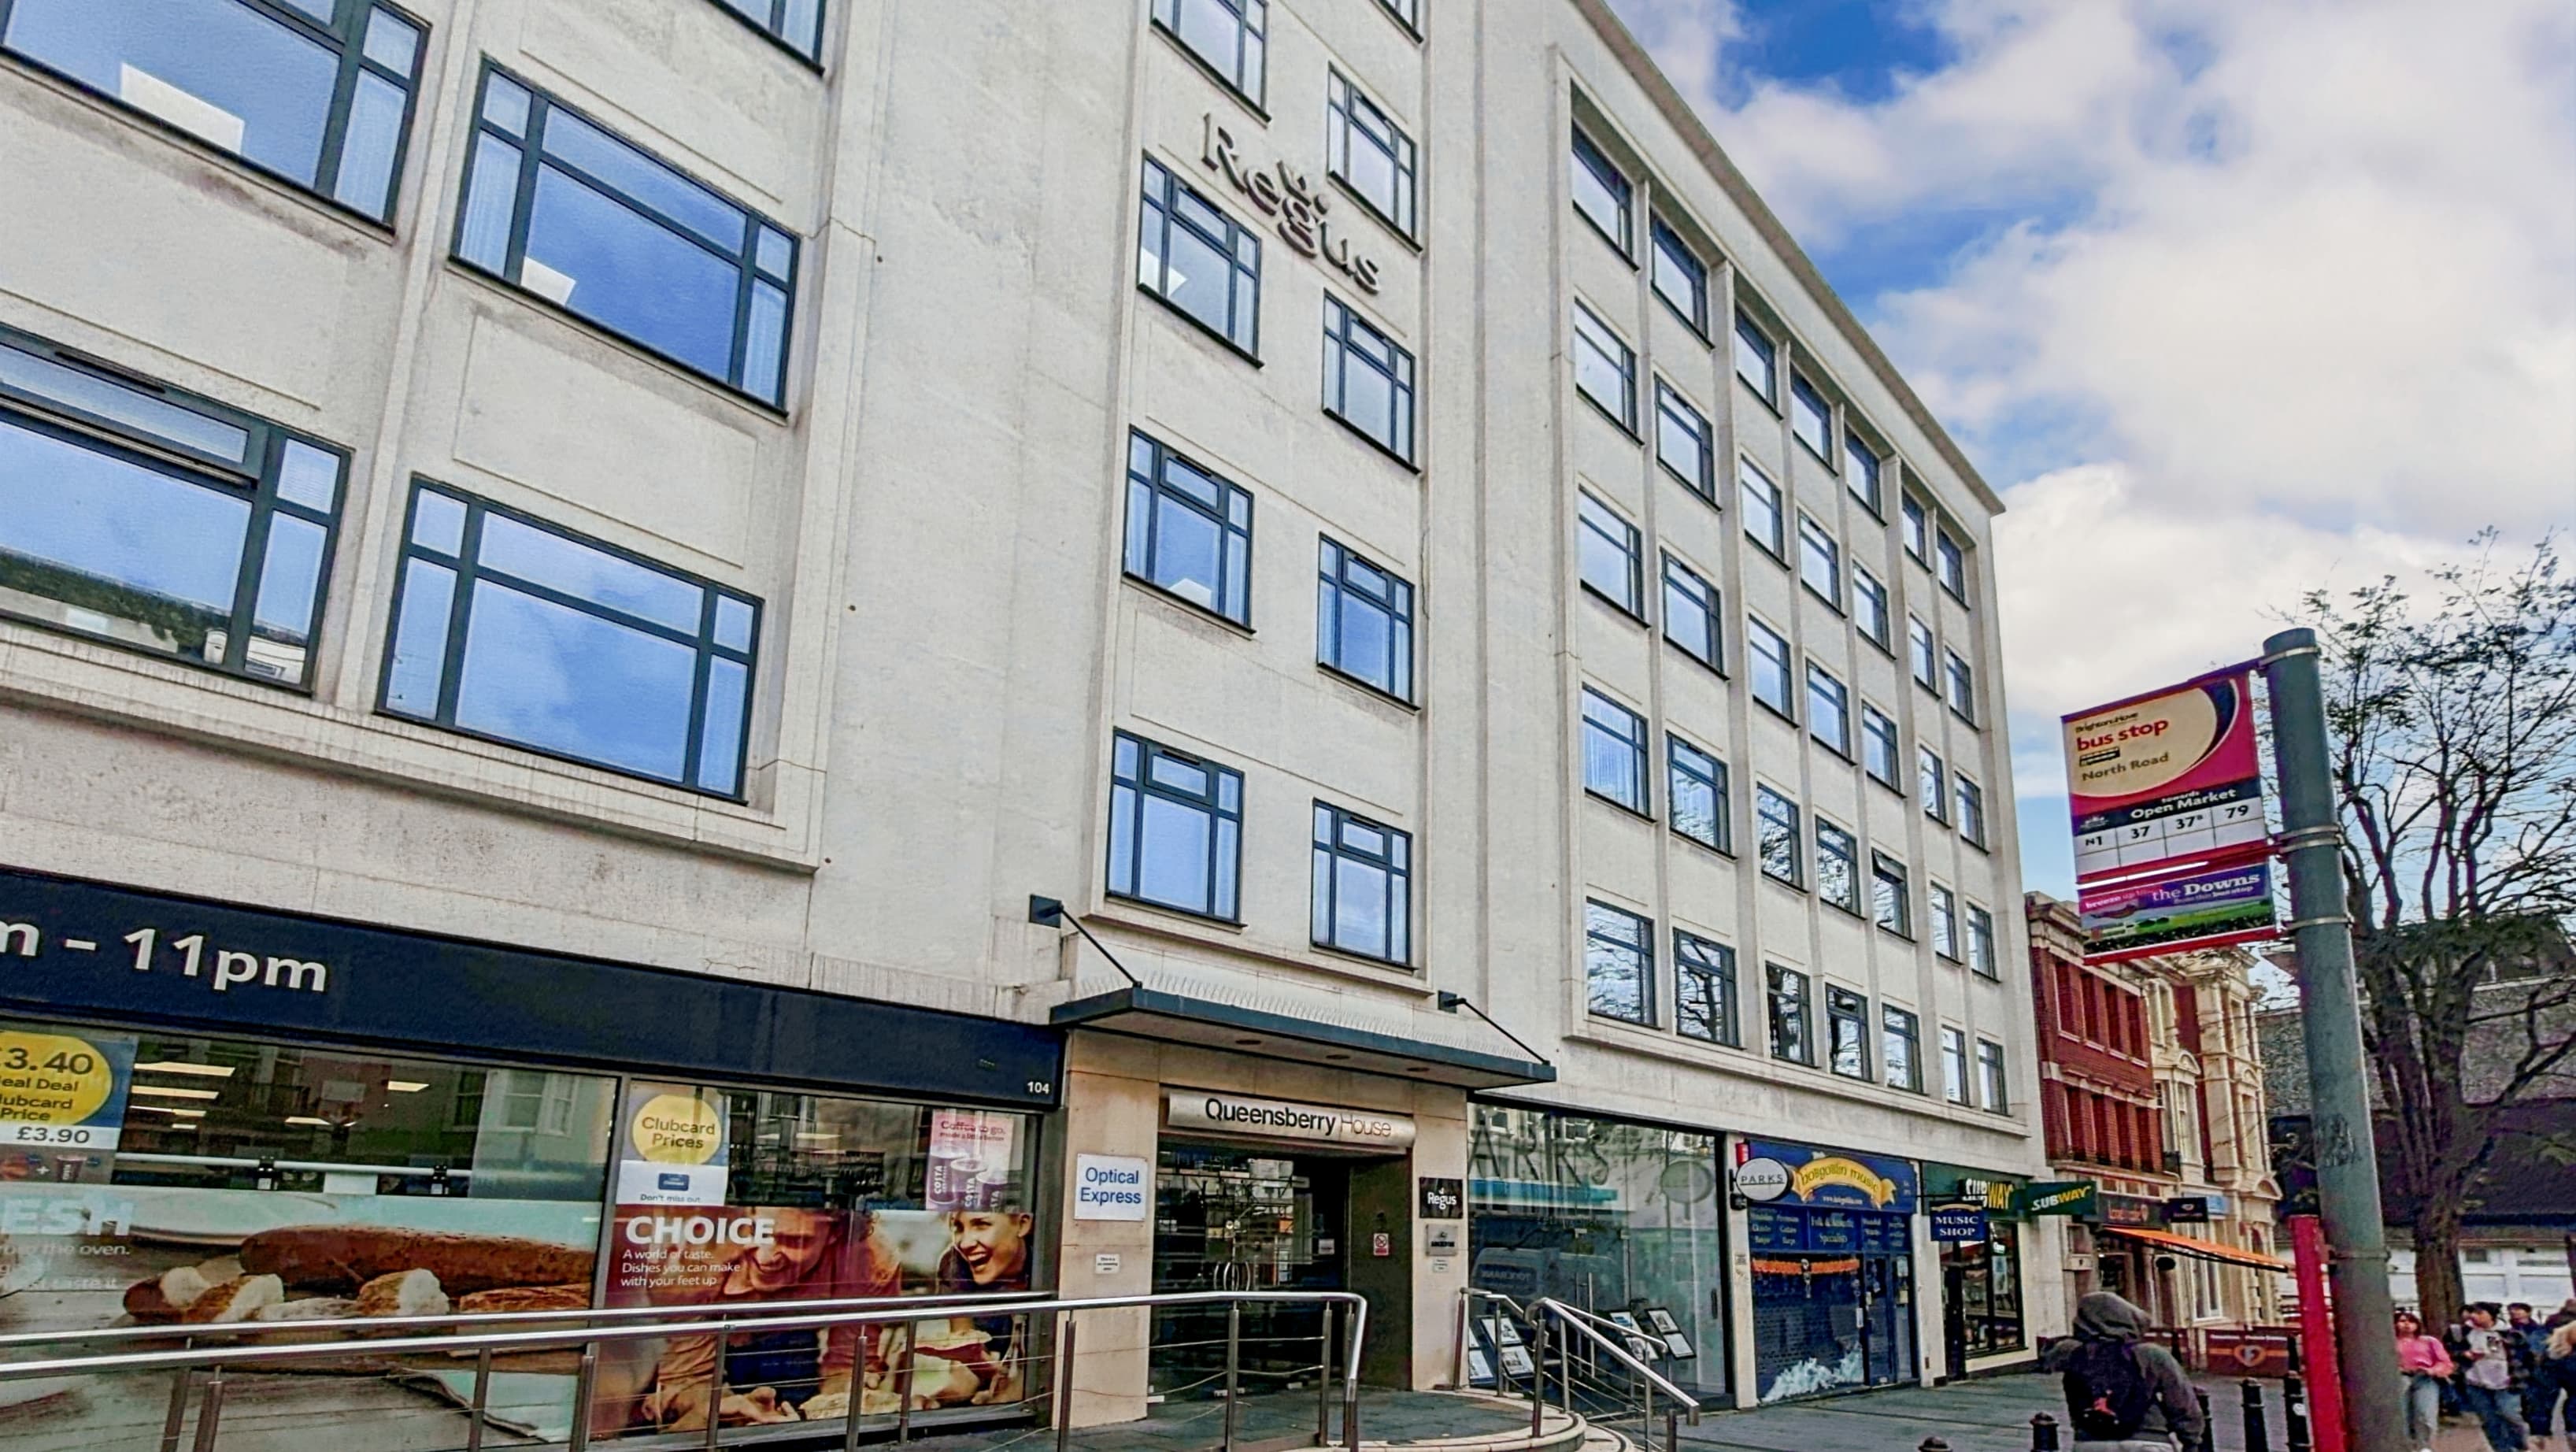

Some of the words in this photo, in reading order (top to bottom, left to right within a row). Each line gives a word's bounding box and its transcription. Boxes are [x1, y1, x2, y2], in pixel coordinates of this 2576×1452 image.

[1201, 112, 1380, 296] Regus
[2076, 734, 2113, 751] bus
[2118, 720, 2168, 741] stop
[2082, 764, 2126, 781] North
[2130, 752, 2169, 769] Road
[2130, 802, 2173, 820] Open
[2177, 788, 2237, 809] Market
[2161, 791, 2200, 803] towards
[2225, 805, 2248, 819] 79
[2085, 836, 2102, 846] N1
[2131, 825, 2150, 839] 37
[2086, 895, 2121, 909] breeze
[2152, 887, 2182, 902] the
[2183, 873, 2260, 895] Downs
[124, 928, 326, 991] 11pm
[0, 1047, 94, 1075] 3.40
[0, 1076, 31, 1088] eal
[36, 1079, 79, 1091] Deal
[1027, 1081, 1050, 1095] 104
[0, 1094, 72, 1109] lubcard
[1, 1107, 50, 1120] Price
[1205, 1098, 1336, 1136] Queensberry
[1340, 1113, 1391, 1137] House
[17, 1126, 90, 1143] £3.90
[642, 1117, 716, 1135] Clubcard
[652, 1132, 704, 1149] Prices
[1468, 1119, 1608, 1186] ARKS
[934, 1165, 943, 1195] COSTA
[1085, 1167, 1139, 1186] Optical
[1741, 1174, 1784, 1183] PARKS
[1850, 1168, 1879, 1190] music
[964, 1178, 975, 1207] COSTA
[990, 1191, 1001, 1208] STA
[1080, 1187, 1142, 1206] Express
[1427, 1191, 1456, 1209] Regus
[1963, 1178, 2014, 1209] SUBWAY
[2031, 1186, 2091, 1212] SUBWAY
[1936, 1216, 1979, 1224] MUSIC
[626, 1215, 776, 1246] CHOICE
[1939, 1228, 1975, 1237] SHOP
[80, 1245, 131, 1256] oven.
[622, 1250, 633, 1259] A
[635, 1249, 667, 1260] world
[669, 1248, 682, 1259] of
[684, 1250, 714, 1260] taste.
[622, 1263, 661, 1273] Dishes
[663, 1264, 684, 1275] you
[687, 1264, 707, 1272] can
[709, 1262, 741, 1272] make
[621, 1276, 647, 1287] with
[649, 1277, 675, 1288] your
[677, 1275, 700, 1286] feet
[702, 1276, 717, 1287] up
